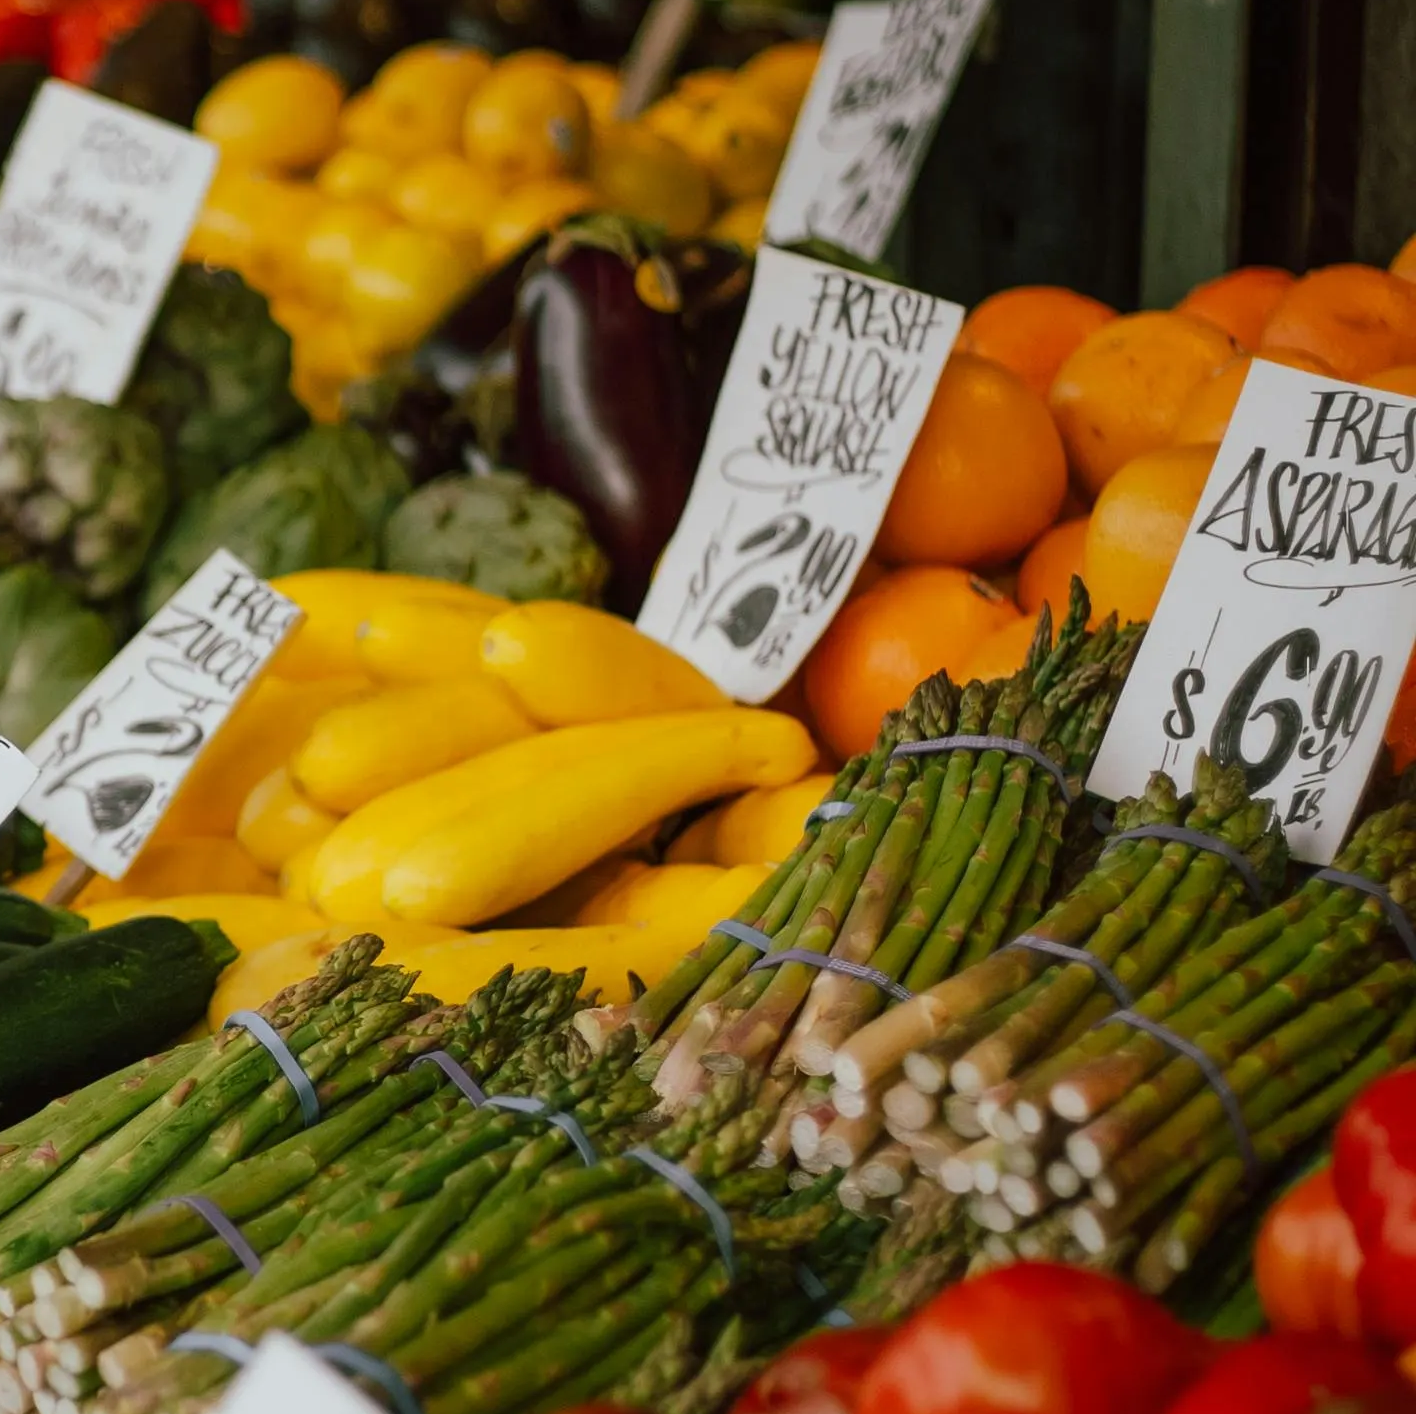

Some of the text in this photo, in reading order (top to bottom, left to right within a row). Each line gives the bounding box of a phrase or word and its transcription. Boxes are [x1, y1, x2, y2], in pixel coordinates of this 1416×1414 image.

[810, 272, 942, 353] FRESH
[760, 324, 921, 422] YELLOW
[756, 393, 889, 475] SQUASH
